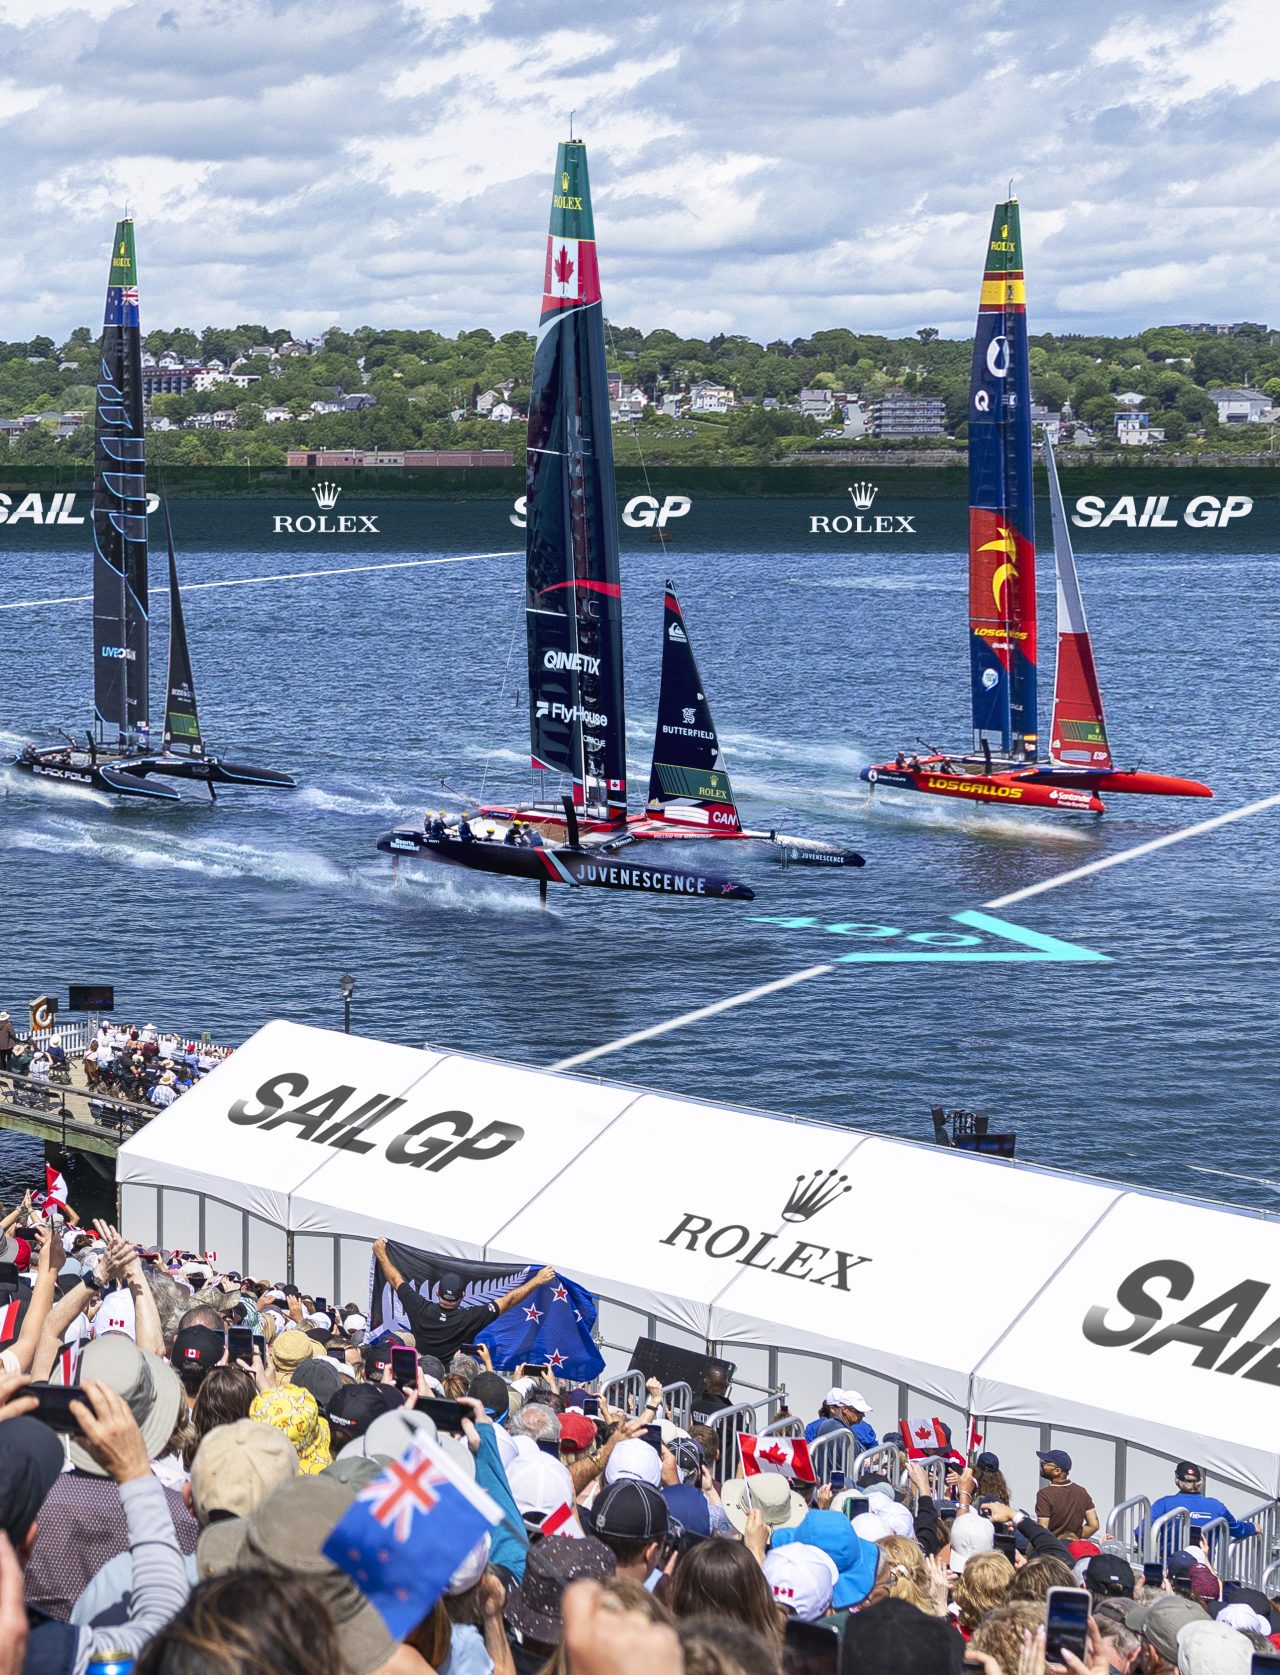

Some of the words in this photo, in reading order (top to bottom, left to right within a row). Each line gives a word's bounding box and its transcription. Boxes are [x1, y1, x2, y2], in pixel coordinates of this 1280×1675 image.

[553, 195, 583, 210] ROLEX
[991, 241, 1015, 252] ROLEX
[543, 651, 601, 676] QINETIX
[552, 705, 608, 728] FlyHouse
[662, 725, 714, 740] BUTTERFIELD
[33, 764, 64, 779] BLACK
[698, 786, 727, 799] ROLEX
[1058, 791, 1092, 803] Santander
[712, 811, 736, 826] CAN
[395, 838, 415, 846] Sports
[801, 852, 845, 864] JUVENESCENCE
[576, 864, 707, 895] JUVENESCENCE
[658, 1212, 873, 1292] ROLEX
